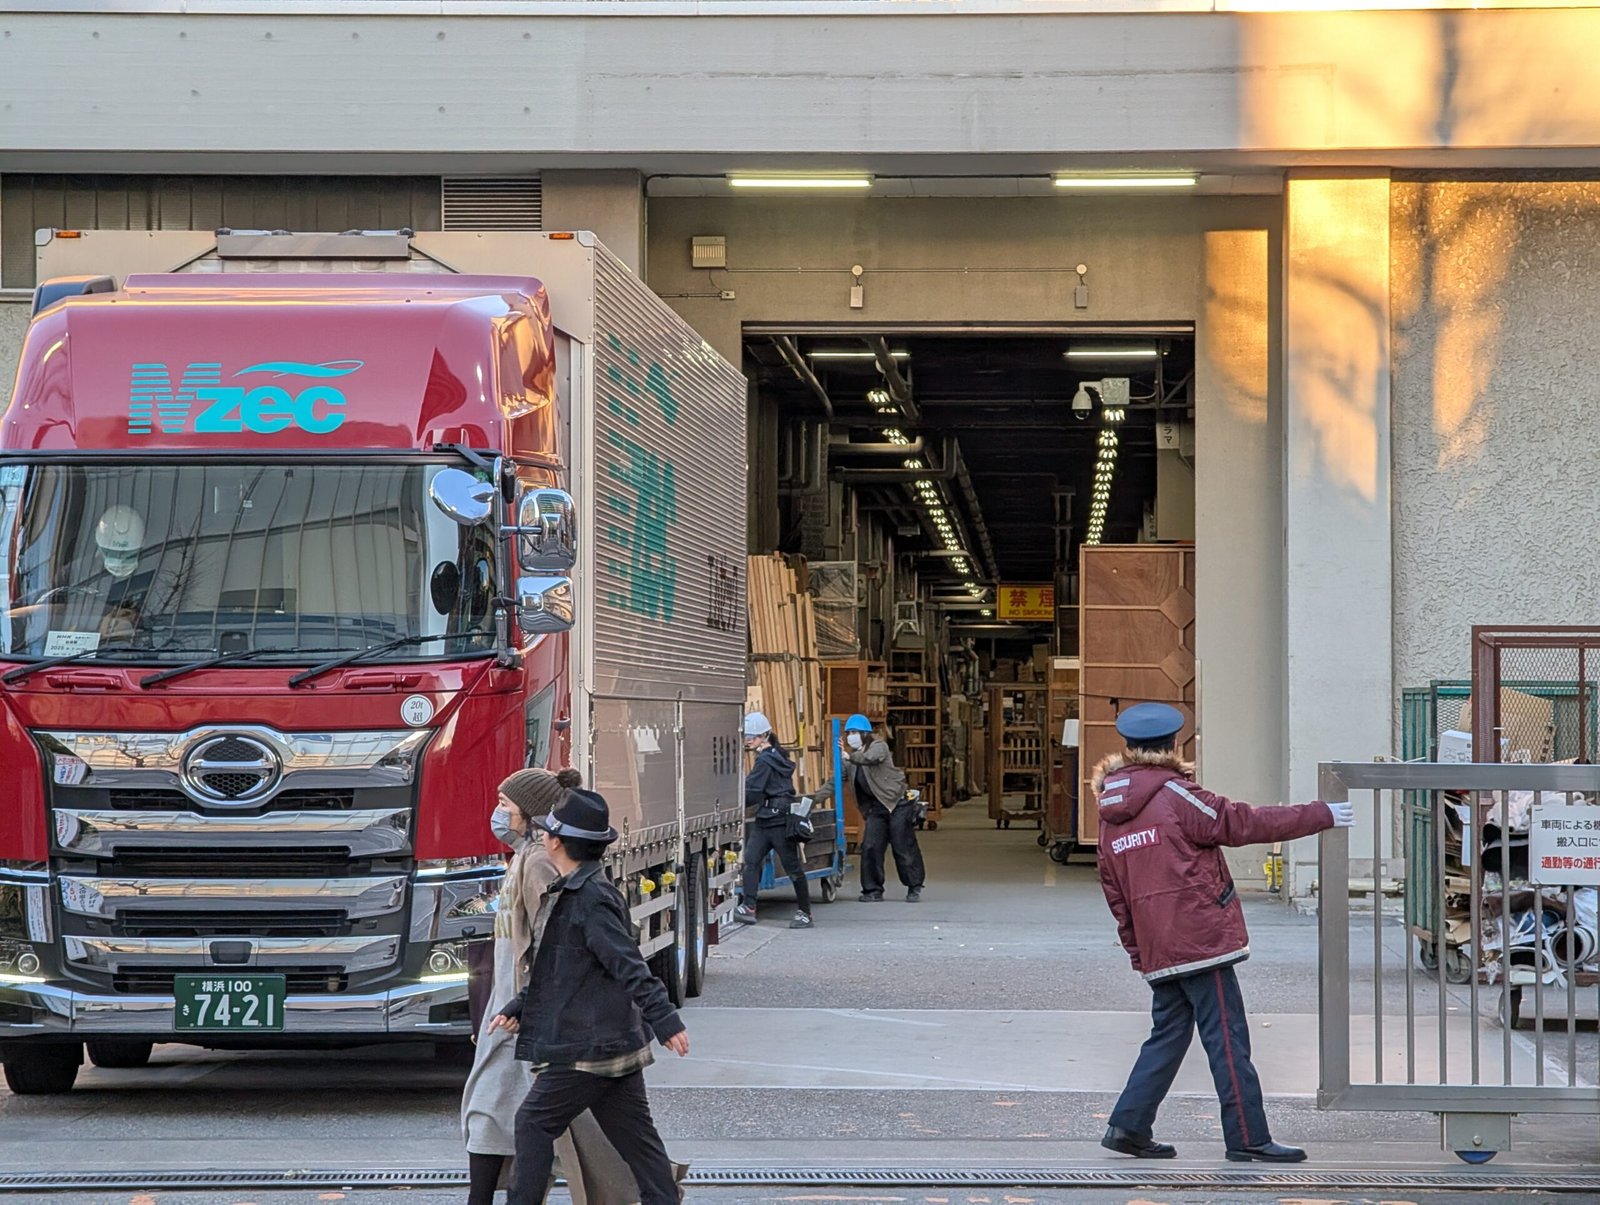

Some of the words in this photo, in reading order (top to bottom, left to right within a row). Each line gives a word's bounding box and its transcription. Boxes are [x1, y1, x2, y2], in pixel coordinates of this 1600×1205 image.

[128, 363, 347, 434] Mzec
[1009, 608, 1021, 616] NO
[1111, 828, 1156, 854] SECURITY
[1556, 836, 1600, 848] 搬入口に
[201, 980, 225, 993] 横浜
[228, 980, 252, 993] 100
[182, 1003, 190, 1017] き
[194, 993, 274, 1026] 74-21
